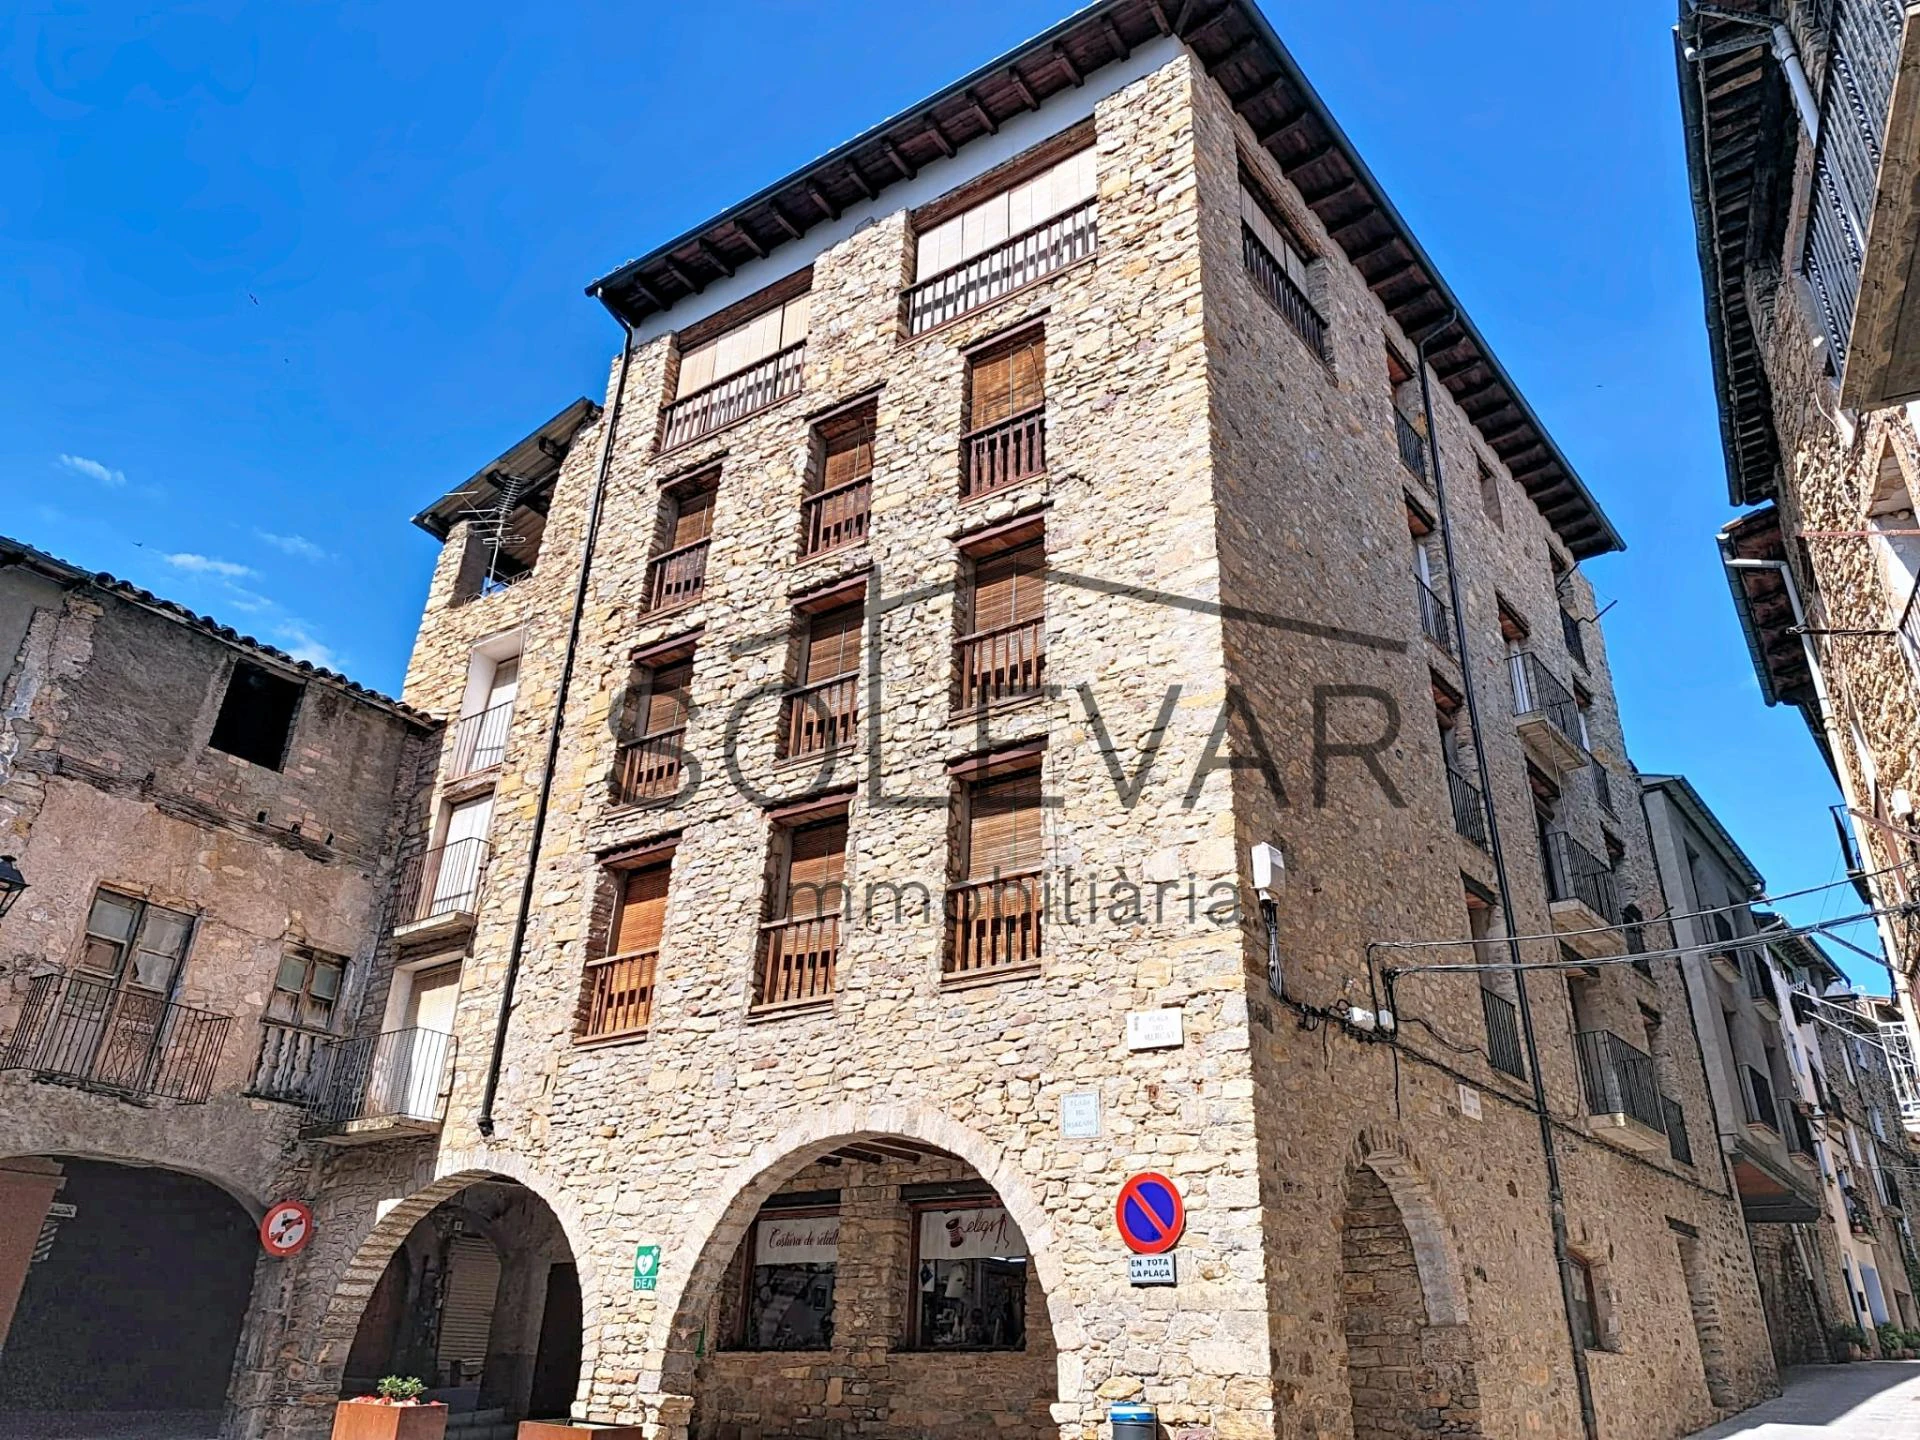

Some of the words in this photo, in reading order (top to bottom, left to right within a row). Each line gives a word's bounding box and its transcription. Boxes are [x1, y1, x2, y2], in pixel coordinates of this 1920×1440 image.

[804, 1230, 814, 1246] de
[1131, 1259, 1142, 1267] EN
[1147, 1258, 1169, 1266] TOTA
[635, 1279, 653, 1289] DEA
